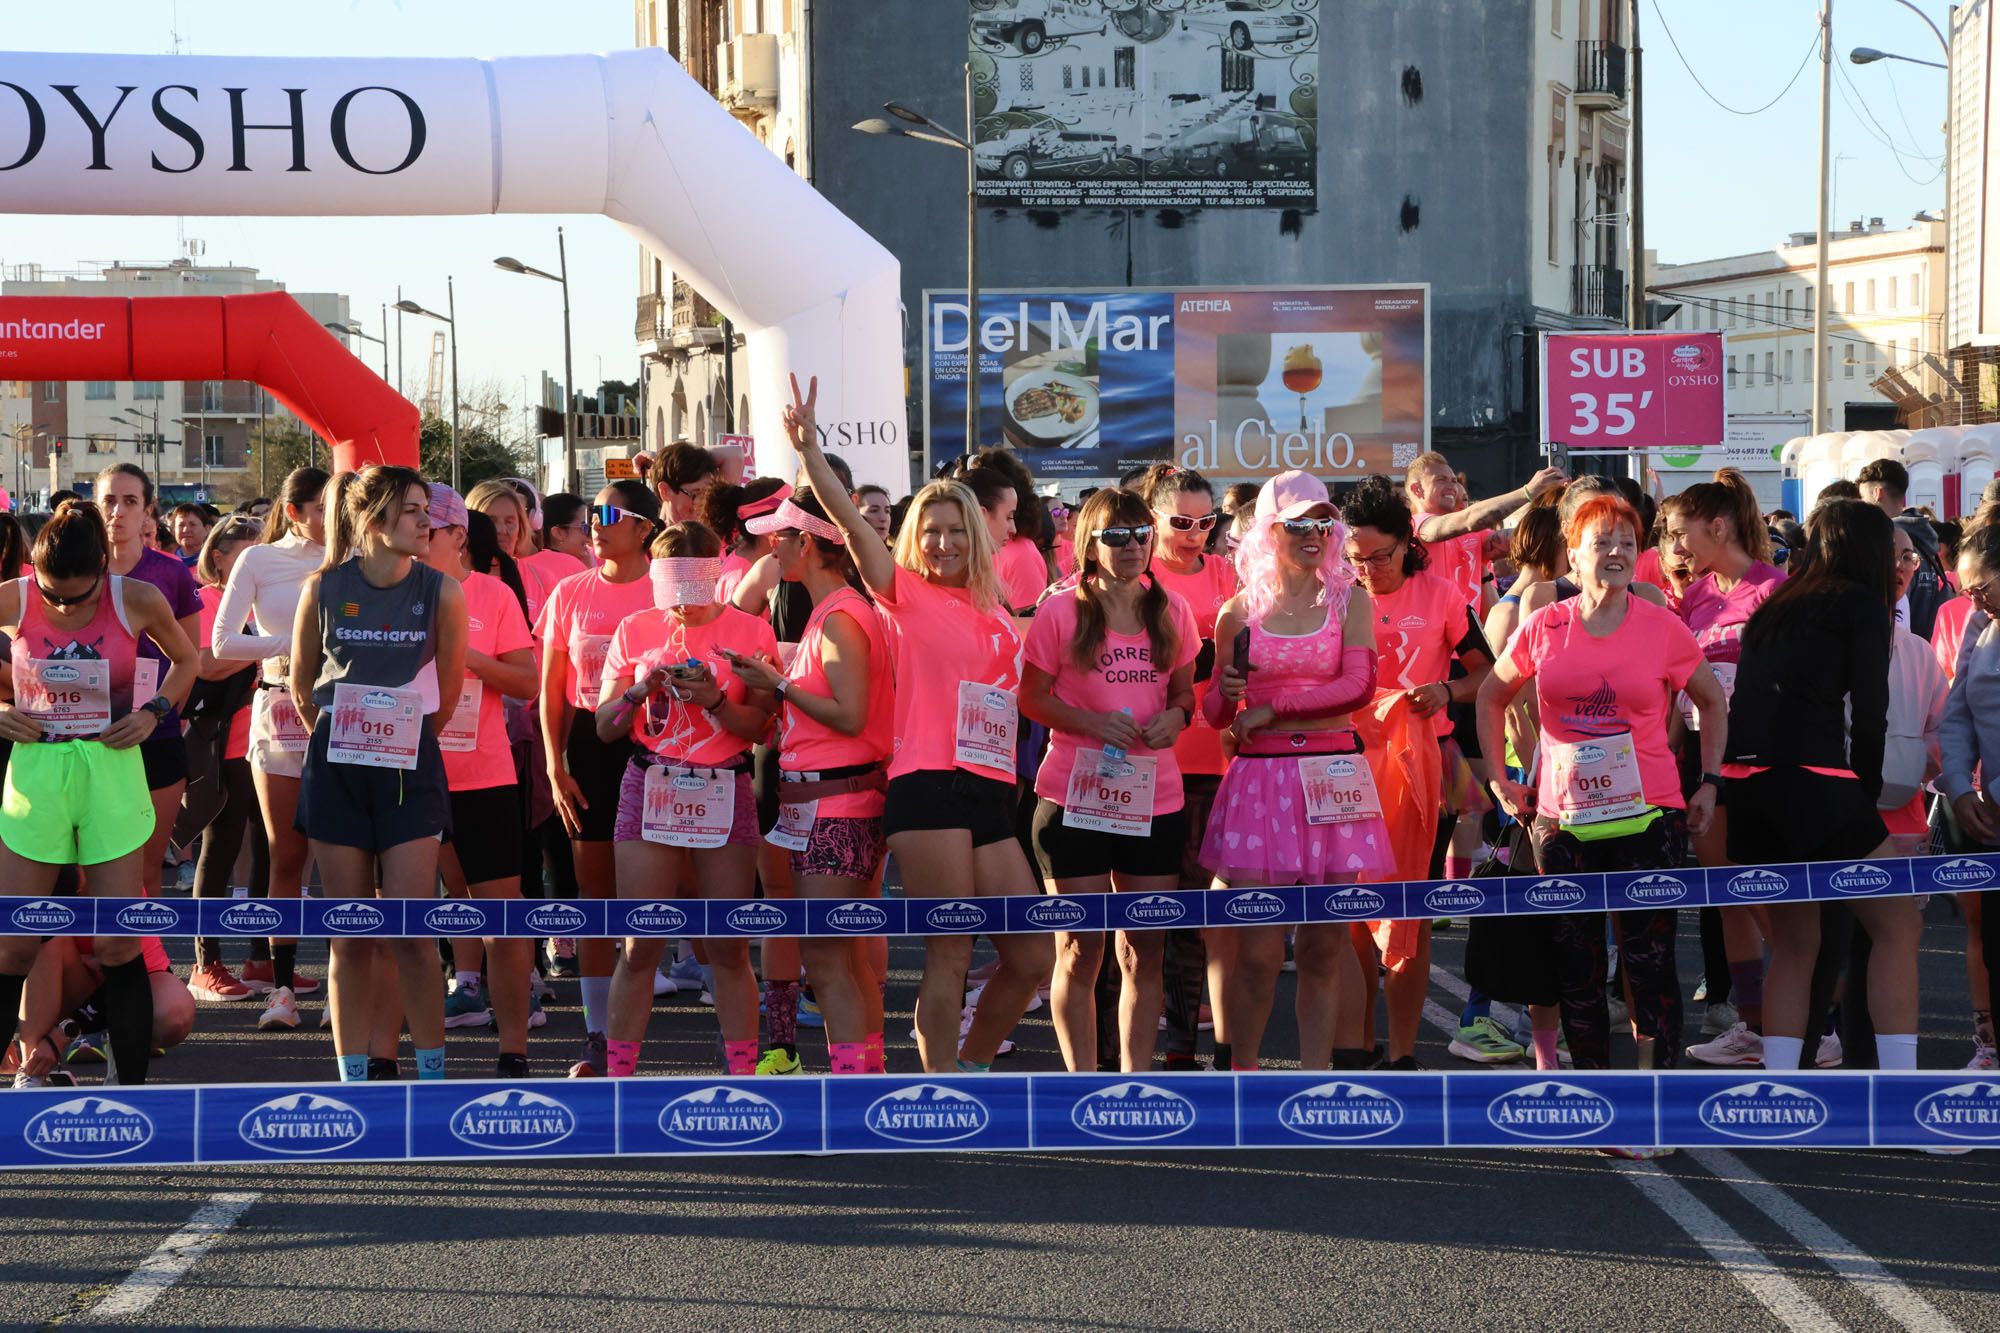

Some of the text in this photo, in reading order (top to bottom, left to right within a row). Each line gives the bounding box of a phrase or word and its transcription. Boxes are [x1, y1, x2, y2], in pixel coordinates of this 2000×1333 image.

[1181, 300, 1232, 312] ATENEA
[0, 318, 106, 340] ntander
[934, 302, 1170, 352] Del Mar
[1570, 348, 1646, 378] SUB
[1668, 374, 1719, 386] OYSHO
[816, 420, 897, 447] YSHO
[1182, 418, 1366, 470] al Cielo.
[336, 625, 426, 641] Esenciarun
[1106, 670, 1158, 683] CORRE
[48, 692, 80, 703] 016
[365, 697, 395, 706] ASTURIANA
[362, 722, 394, 736] 016
[984, 722, 1006, 738] 016
[336, 752, 365, 760] OYSHO
[1574, 752, 1604, 761] ASTURIANA
[675, 779, 706, 787] ASTURIANA
[1579, 775, 1612, 791] 016
[1100, 788, 1132, 804] 016
[1334, 790, 1362, 804] 016
[674, 803, 706, 816] 016
[1608, 805, 1636, 815] Santander
[1074, 816, 1101, 826] OYSHO
[1118, 822, 1142, 830] Santander
[1834, 876, 1887, 888] ASTURIANA
[1938, 870, 1991, 882] ASTURIANA
[1630, 886, 1682, 897] ASTURIANA
[1732, 880, 1784, 892] ASTURIANA
[1429, 894, 1480, 906] ASTURIANA
[1530, 890, 1582, 902] ASTURIANA
[1230, 904, 1281, 914] ASTURIANA
[1329, 899, 1381, 910] ASTURIANA
[16, 913, 70, 923] ASTURIANA
[931, 912, 982, 924] ASTURIANA
[1030, 910, 1082, 920] ASTURIANA
[1130, 906, 1182, 918] ASTURIANA
[121, 914, 174, 924] ASTURIANA
[224, 914, 278, 925] ASTURIANA
[327, 914, 380, 925] ASTURIANA
[428, 914, 482, 925] ASTURIANA
[530, 914, 582, 925] ASTURIANA
[630, 914, 682, 925] ASTURIANA
[731, 914, 782, 925] ASTURIANA
[830, 914, 883, 924] ASTURIANA
[875, 1106, 980, 1128] ASTURIANA
[1082, 1104, 1186, 1126] ASTURIANA
[1288, 1102, 1394, 1125] ASTURIANA
[1497, 1100, 1604, 1124] ASTURIANA
[1708, 1102, 1818, 1124] ASTURIANA
[1924, 1102, 2000, 1124] ASTURI
[460, 1112, 566, 1135] ASTURIANA
[668, 1110, 774, 1132] ASTURIANA
[34, 1120, 144, 1143] ASTURIANA
[248, 1116, 356, 1139] ASTURIANA
